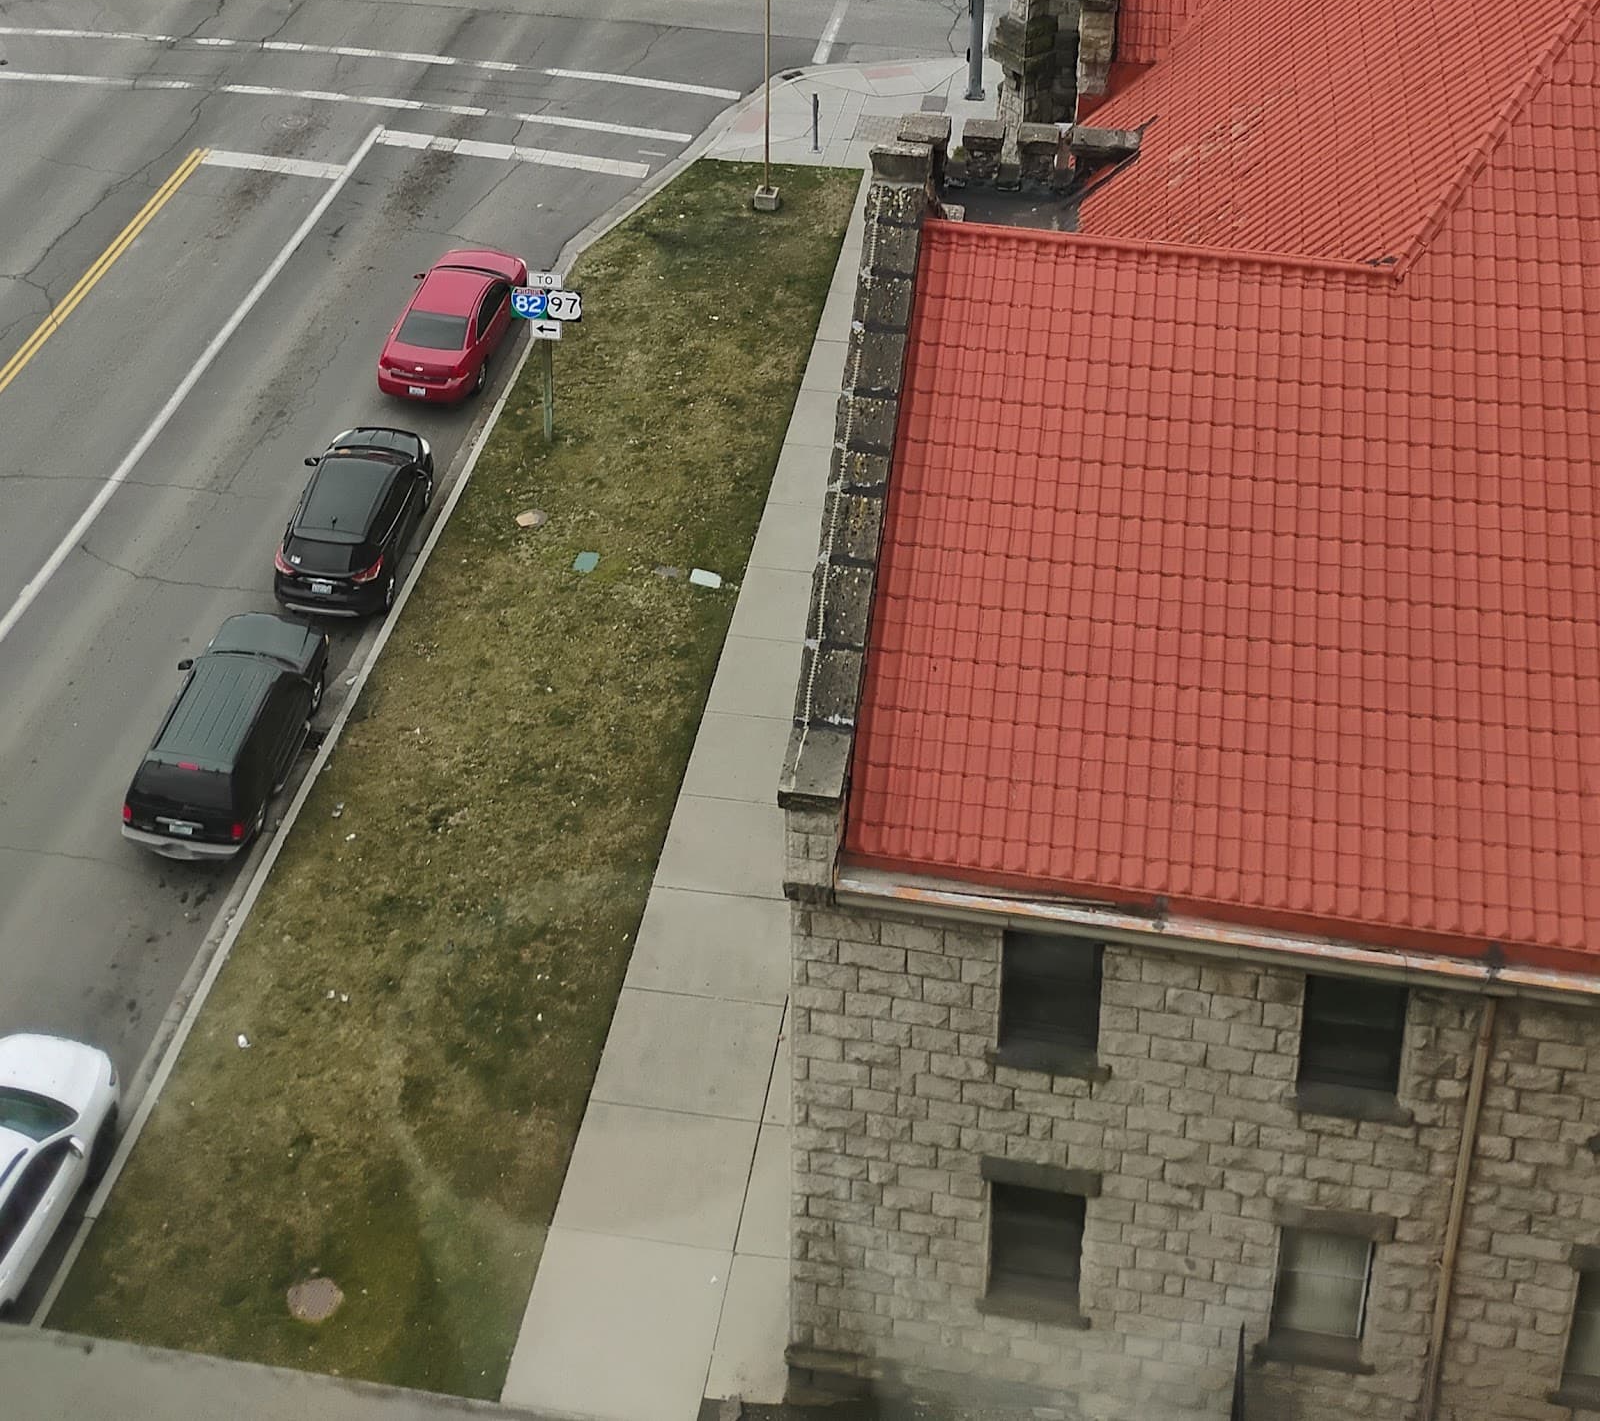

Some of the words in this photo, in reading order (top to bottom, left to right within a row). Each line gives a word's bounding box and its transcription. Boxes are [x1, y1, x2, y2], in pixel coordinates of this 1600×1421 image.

[537, 275, 553, 285] TO
[515, 295, 541, 313] 82
[551, 297, 578, 314] 97
